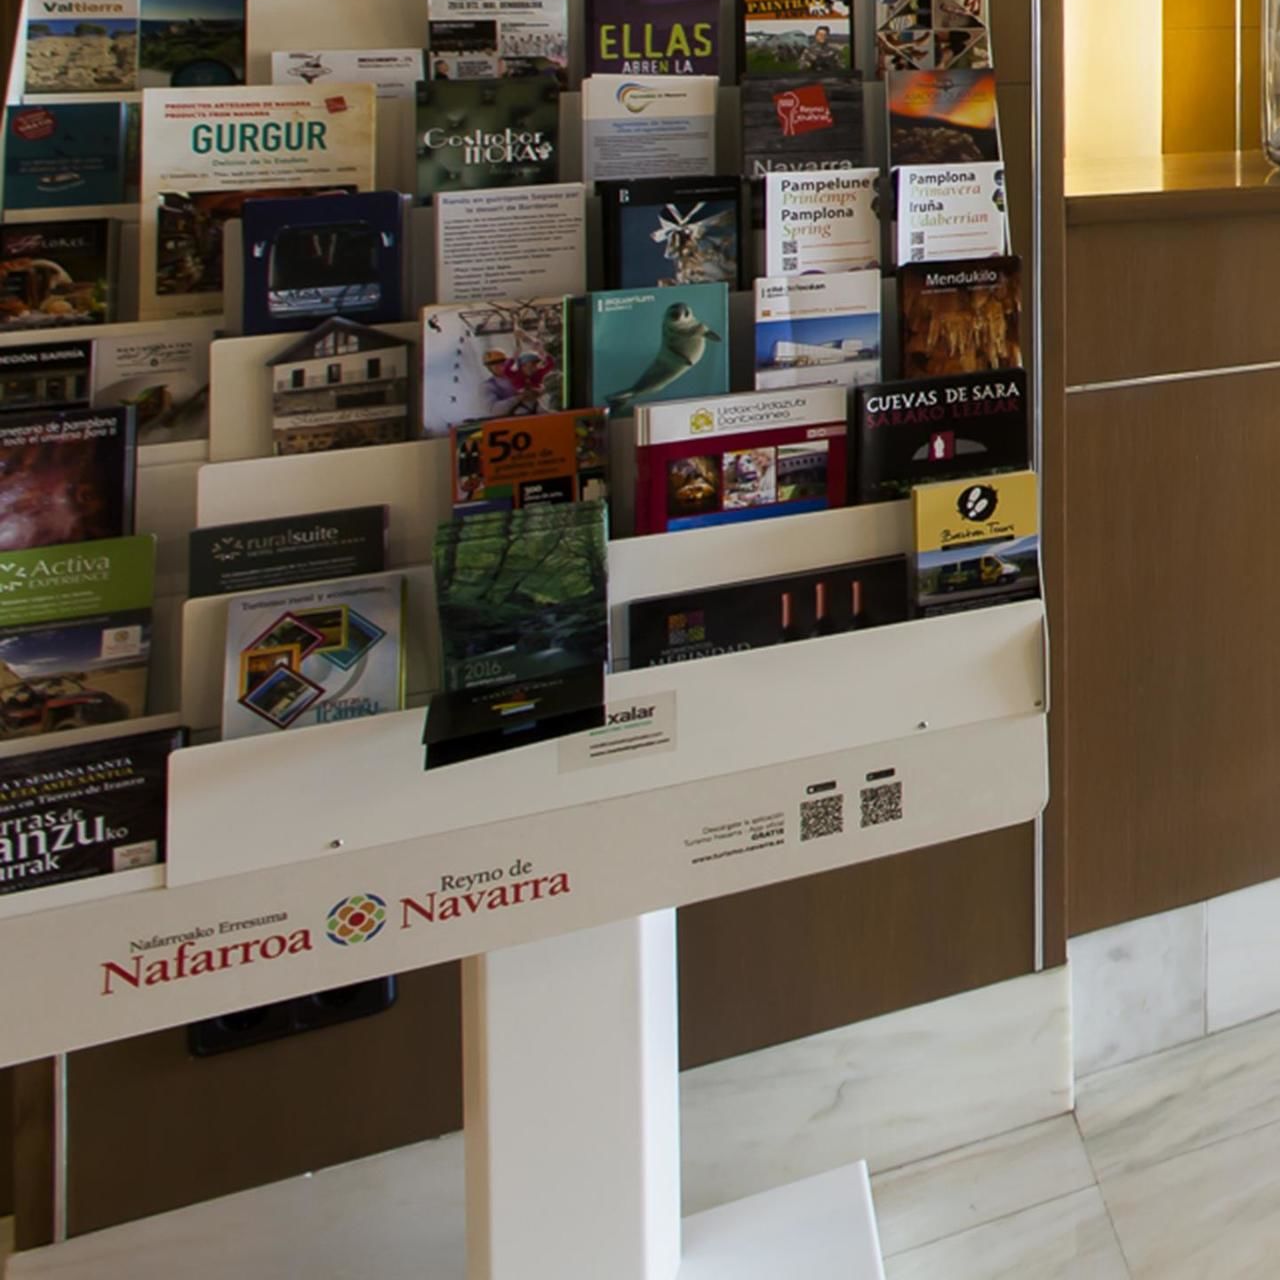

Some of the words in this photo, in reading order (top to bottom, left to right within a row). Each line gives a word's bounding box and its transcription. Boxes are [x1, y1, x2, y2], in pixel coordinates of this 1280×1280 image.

[43, 2, 123, 13] Valtierra
[600, 23, 713, 60] ELLAS
[622, 60, 669, 73] ABREN
[674, 60, 694, 73] LA
[192, 121, 327, 154] GURGUR
[781, 177, 870, 193] Pampelune
[909, 170, 976, 186] Pamplona
[782, 190, 858, 206] Printemps
[909, 199, 944, 213] Iruña
[782, 207, 854, 223] Pamplona
[782, 221, 832, 239] Spring
[925, 269, 998, 287] Mendukilo
[866, 389, 938, 414] CUEVAS
[945, 387, 967, 404] DE
[971, 381, 1020, 401] SARA
[866, 404, 945, 429] SARAKO
[951, 398, 1020, 418] LEZEAK
[488, 429, 533, 465] 50
[246, 525, 339, 551] ruralsuite
[29, 555, 110, 578] Activa
[464, 661, 502, 681] 2016
[607, 705, 656, 725] xalar
[25, 767, 85, 786] SEMANA
[86, 757, 133, 772] SANTA
[78, 767, 134, 783] SANTUA
[38, 790, 83, 805] Tierras
[85, 784, 100, 796] de
[59, 807, 84, 822] de
[751, 827, 785, 841] GRATIS
[440, 864, 504, 893] Reyno
[509, 858, 533, 878] de
[400, 871, 571, 929] Navarra
[129, 924, 216, 953] Nafarroako
[218, 910, 289, 936] Erresuma
[100, 925, 313, 996] Nafarroa
